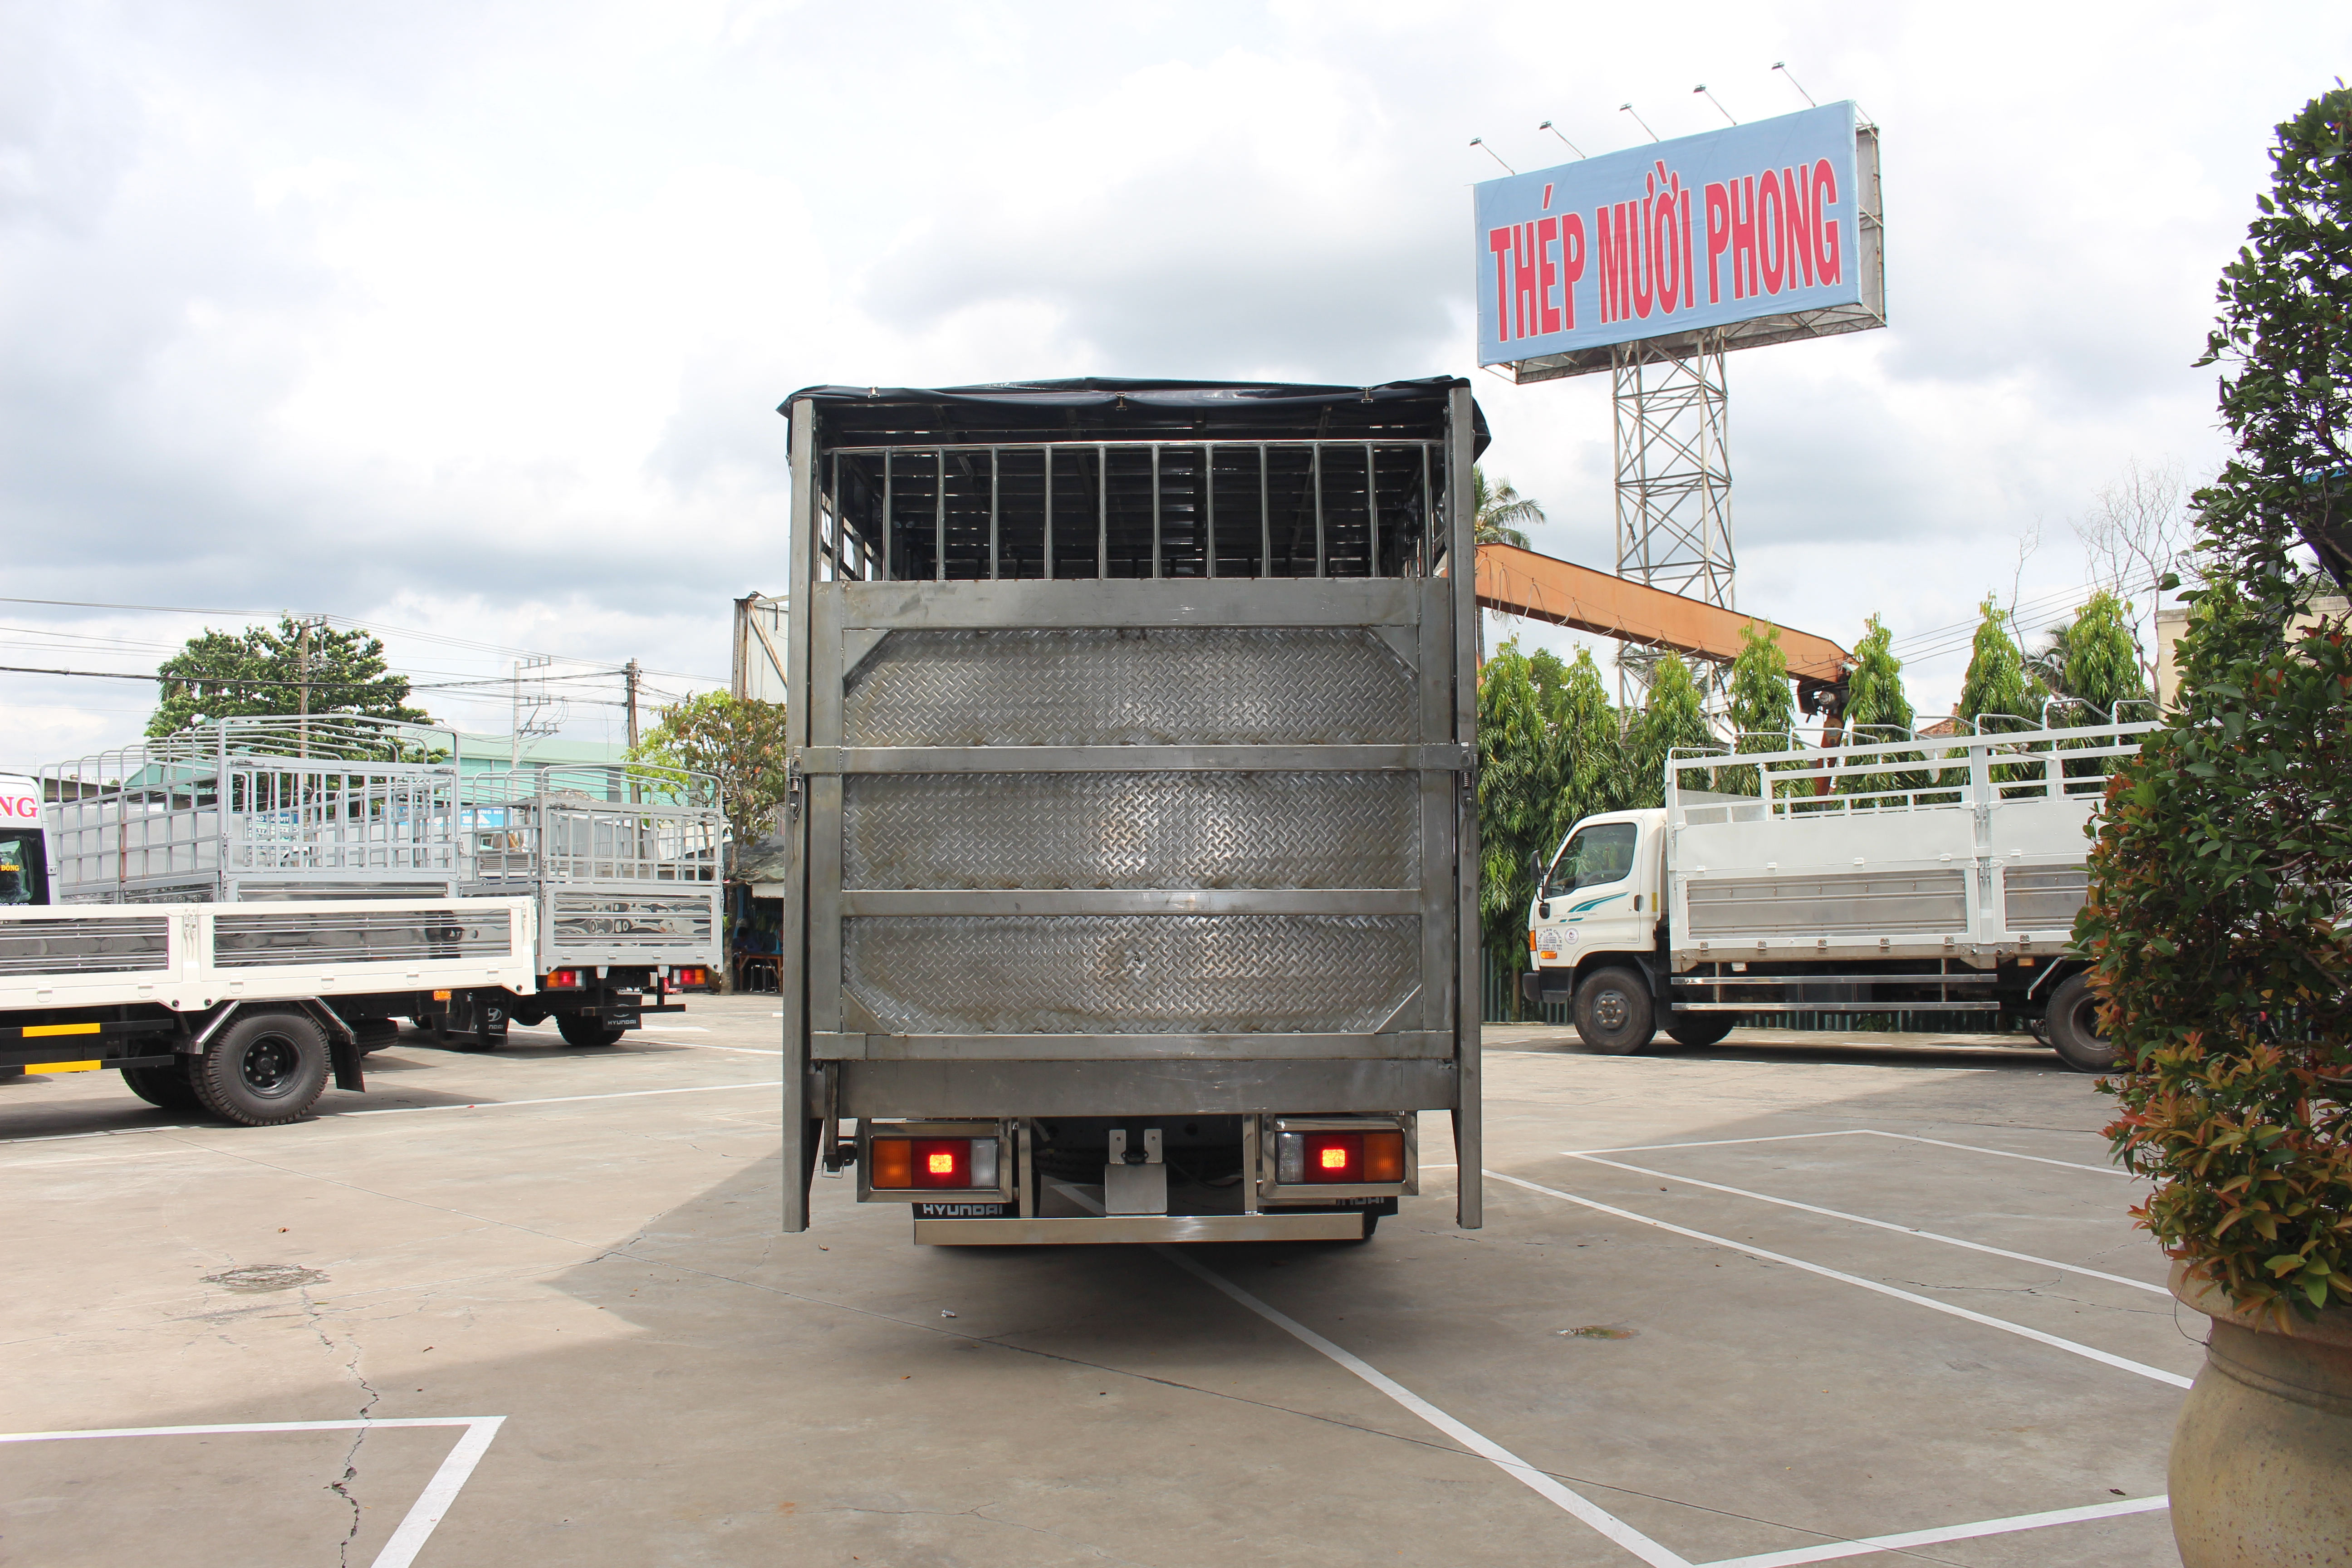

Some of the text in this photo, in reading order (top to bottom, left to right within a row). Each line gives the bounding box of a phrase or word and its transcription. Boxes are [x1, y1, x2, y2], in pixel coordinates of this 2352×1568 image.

[1489, 157, 1842, 343] THÉP MƯỜI PHONG
[923, 1204, 1003, 1215] HYUNDAI
